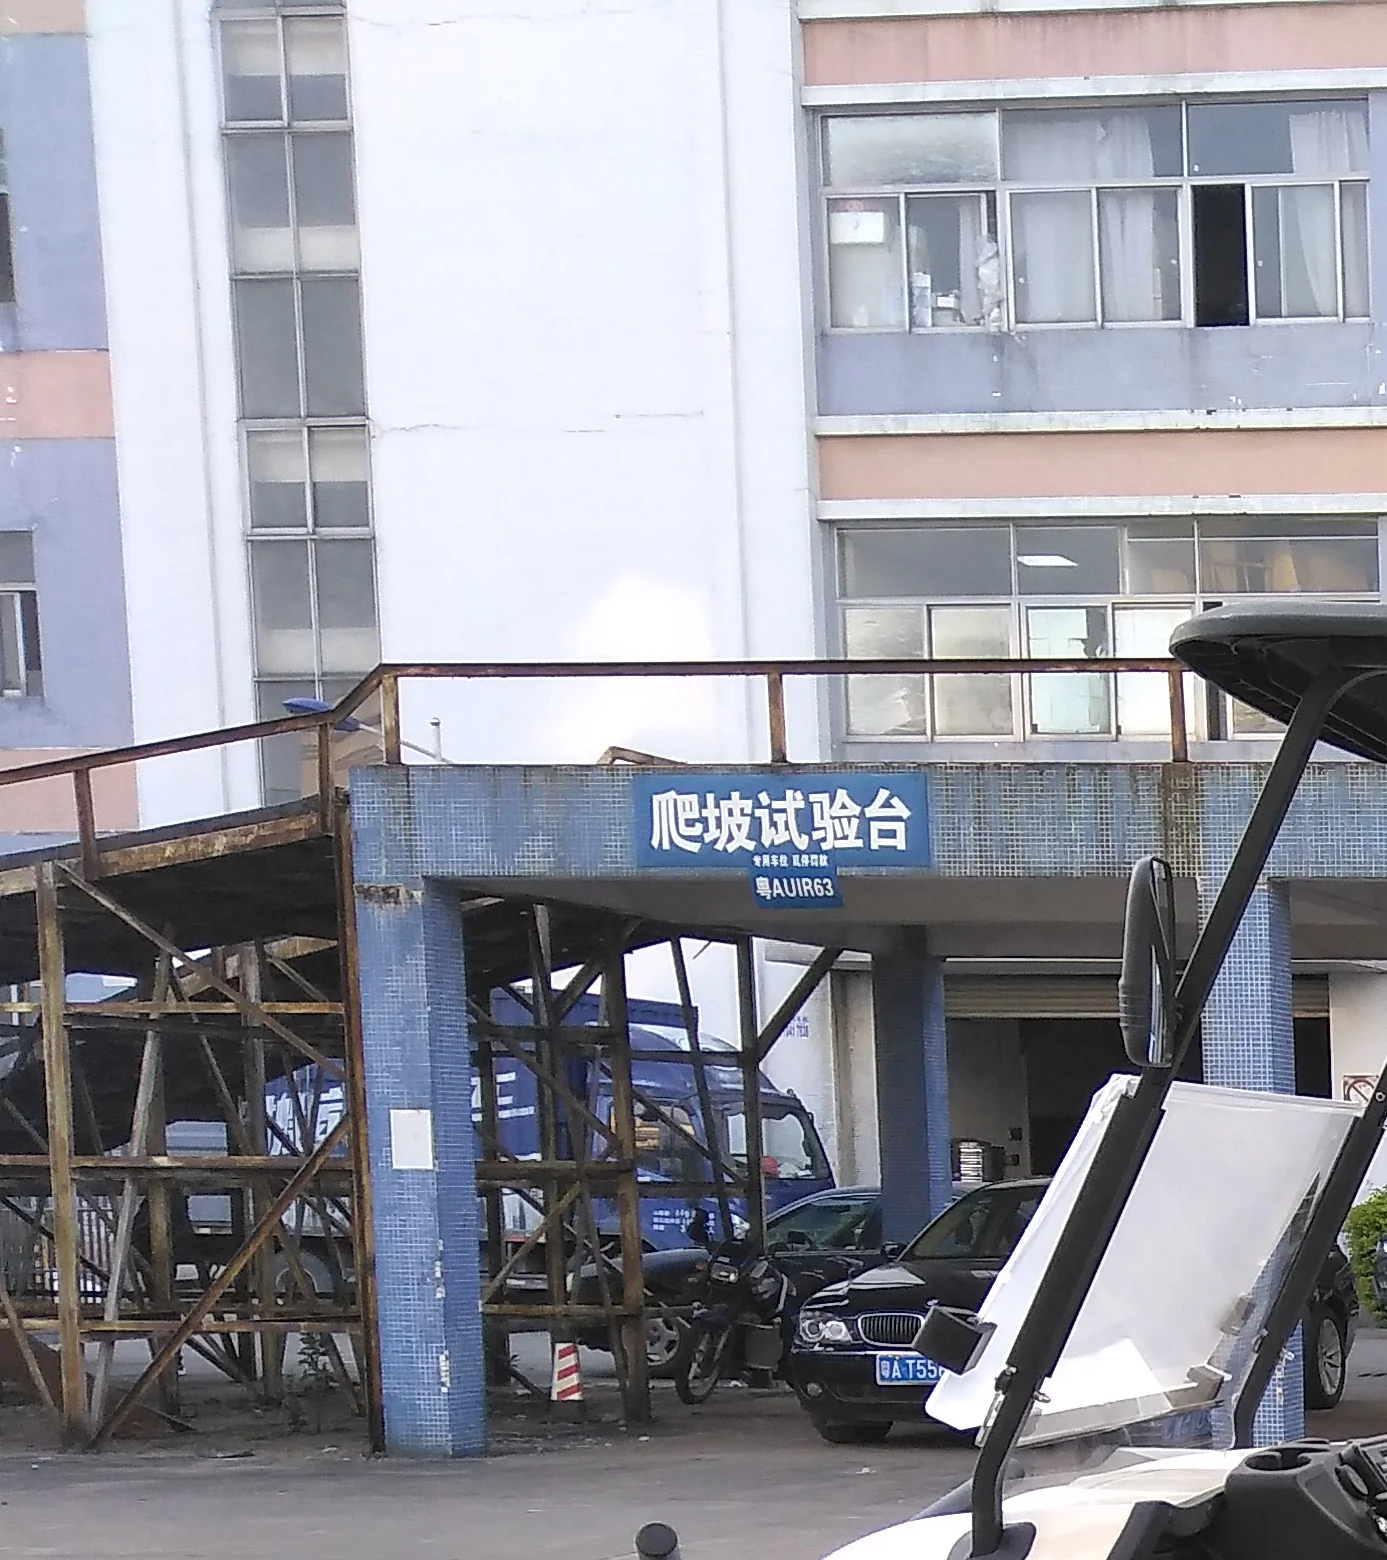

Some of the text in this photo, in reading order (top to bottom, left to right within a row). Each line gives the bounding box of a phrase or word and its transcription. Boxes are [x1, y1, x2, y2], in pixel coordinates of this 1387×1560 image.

[651, 787, 912, 853] 爬坡试验台
